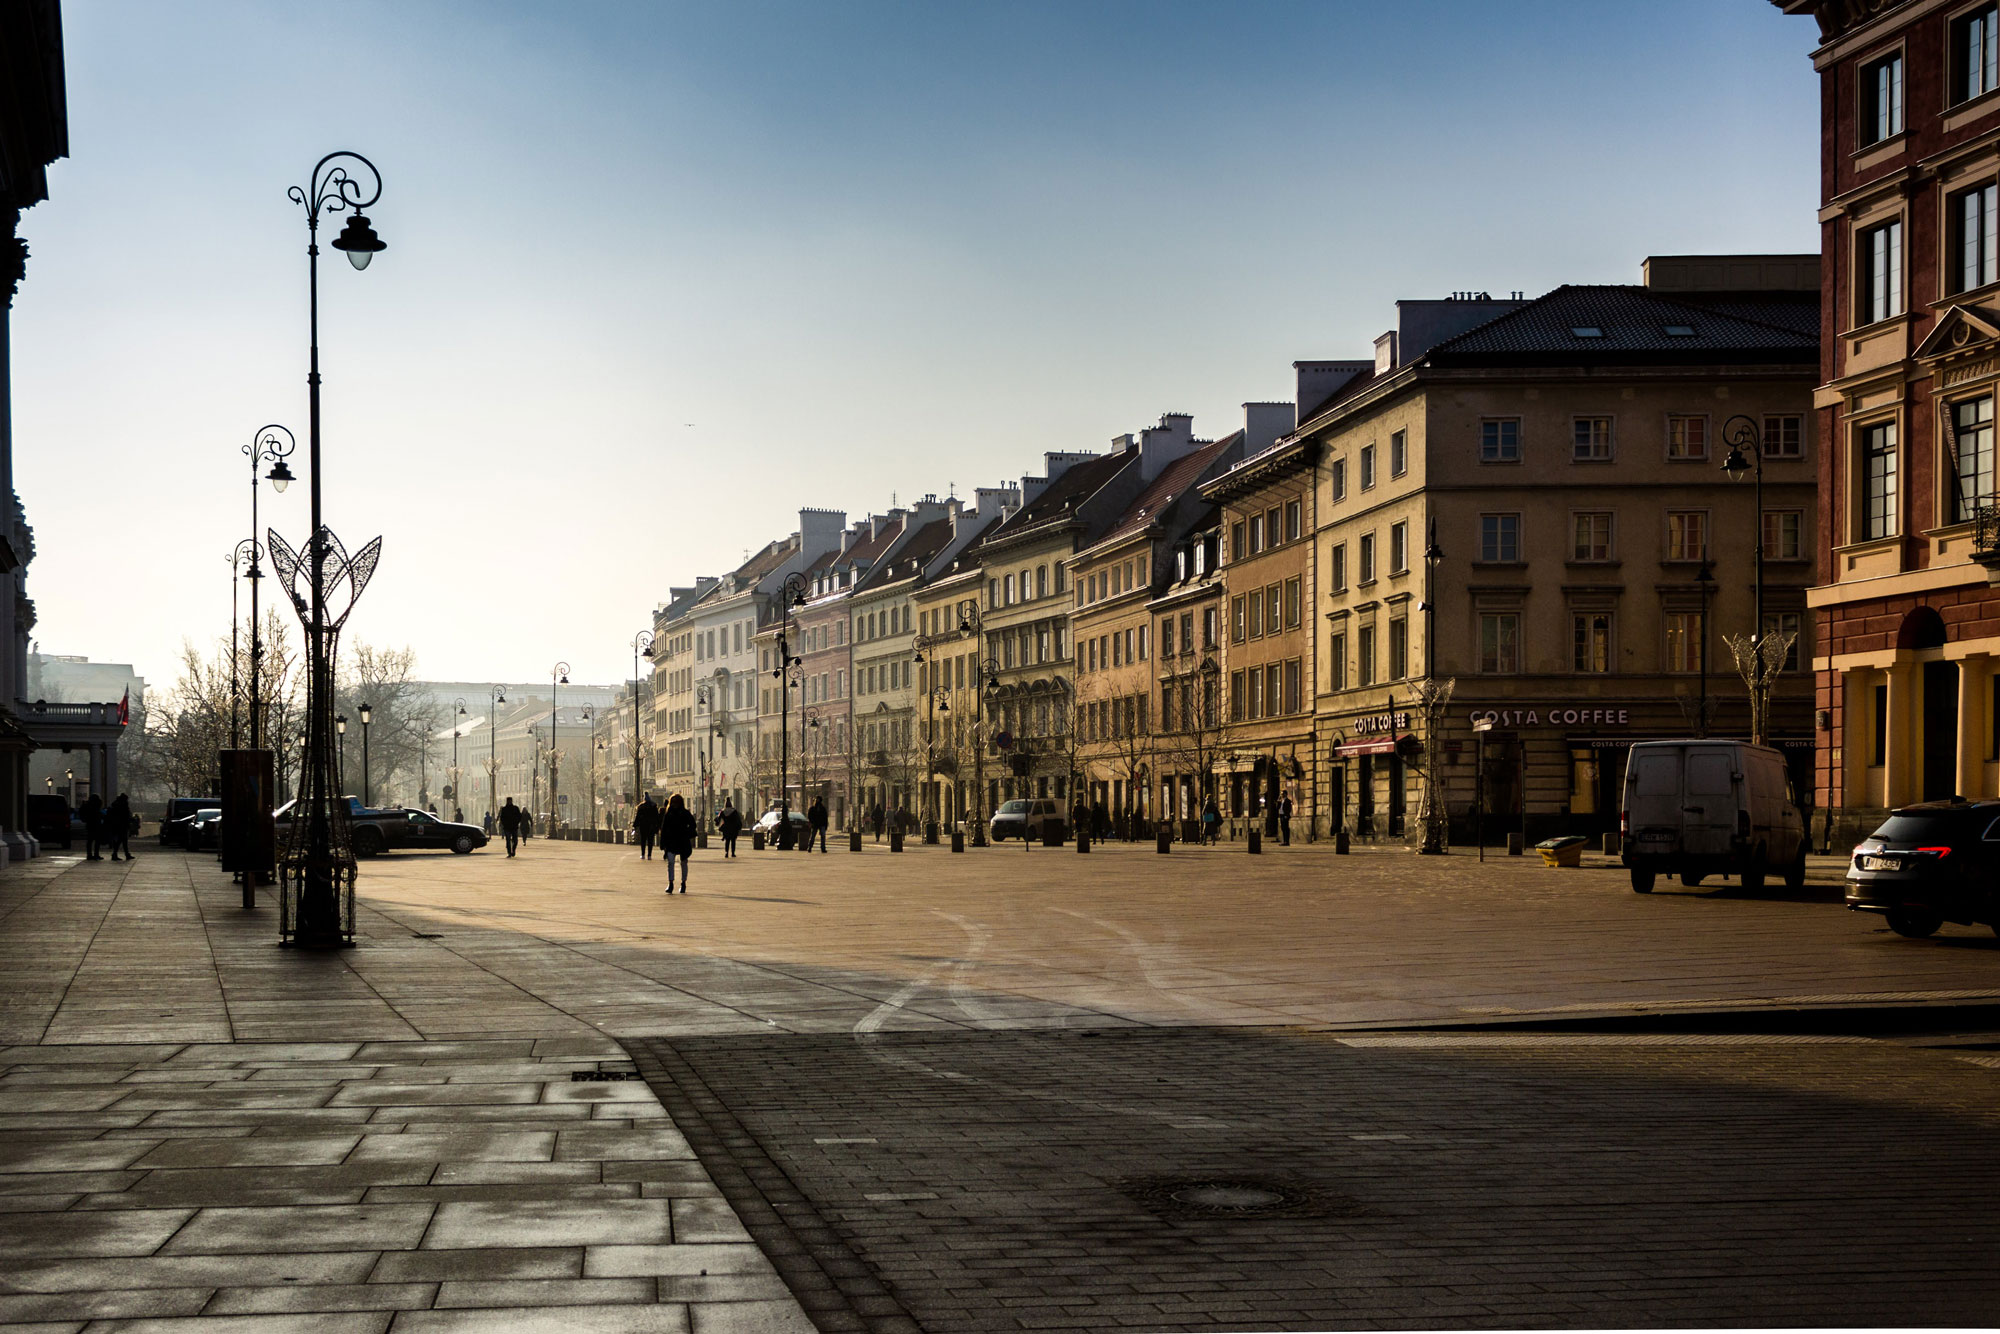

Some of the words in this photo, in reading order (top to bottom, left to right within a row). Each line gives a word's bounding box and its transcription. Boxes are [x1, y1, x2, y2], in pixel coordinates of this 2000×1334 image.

[1353, 717, 1377, 735] COSTA
[1469, 710, 1539, 727] COSTA
[1548, 709, 1629, 725] COFFEE
